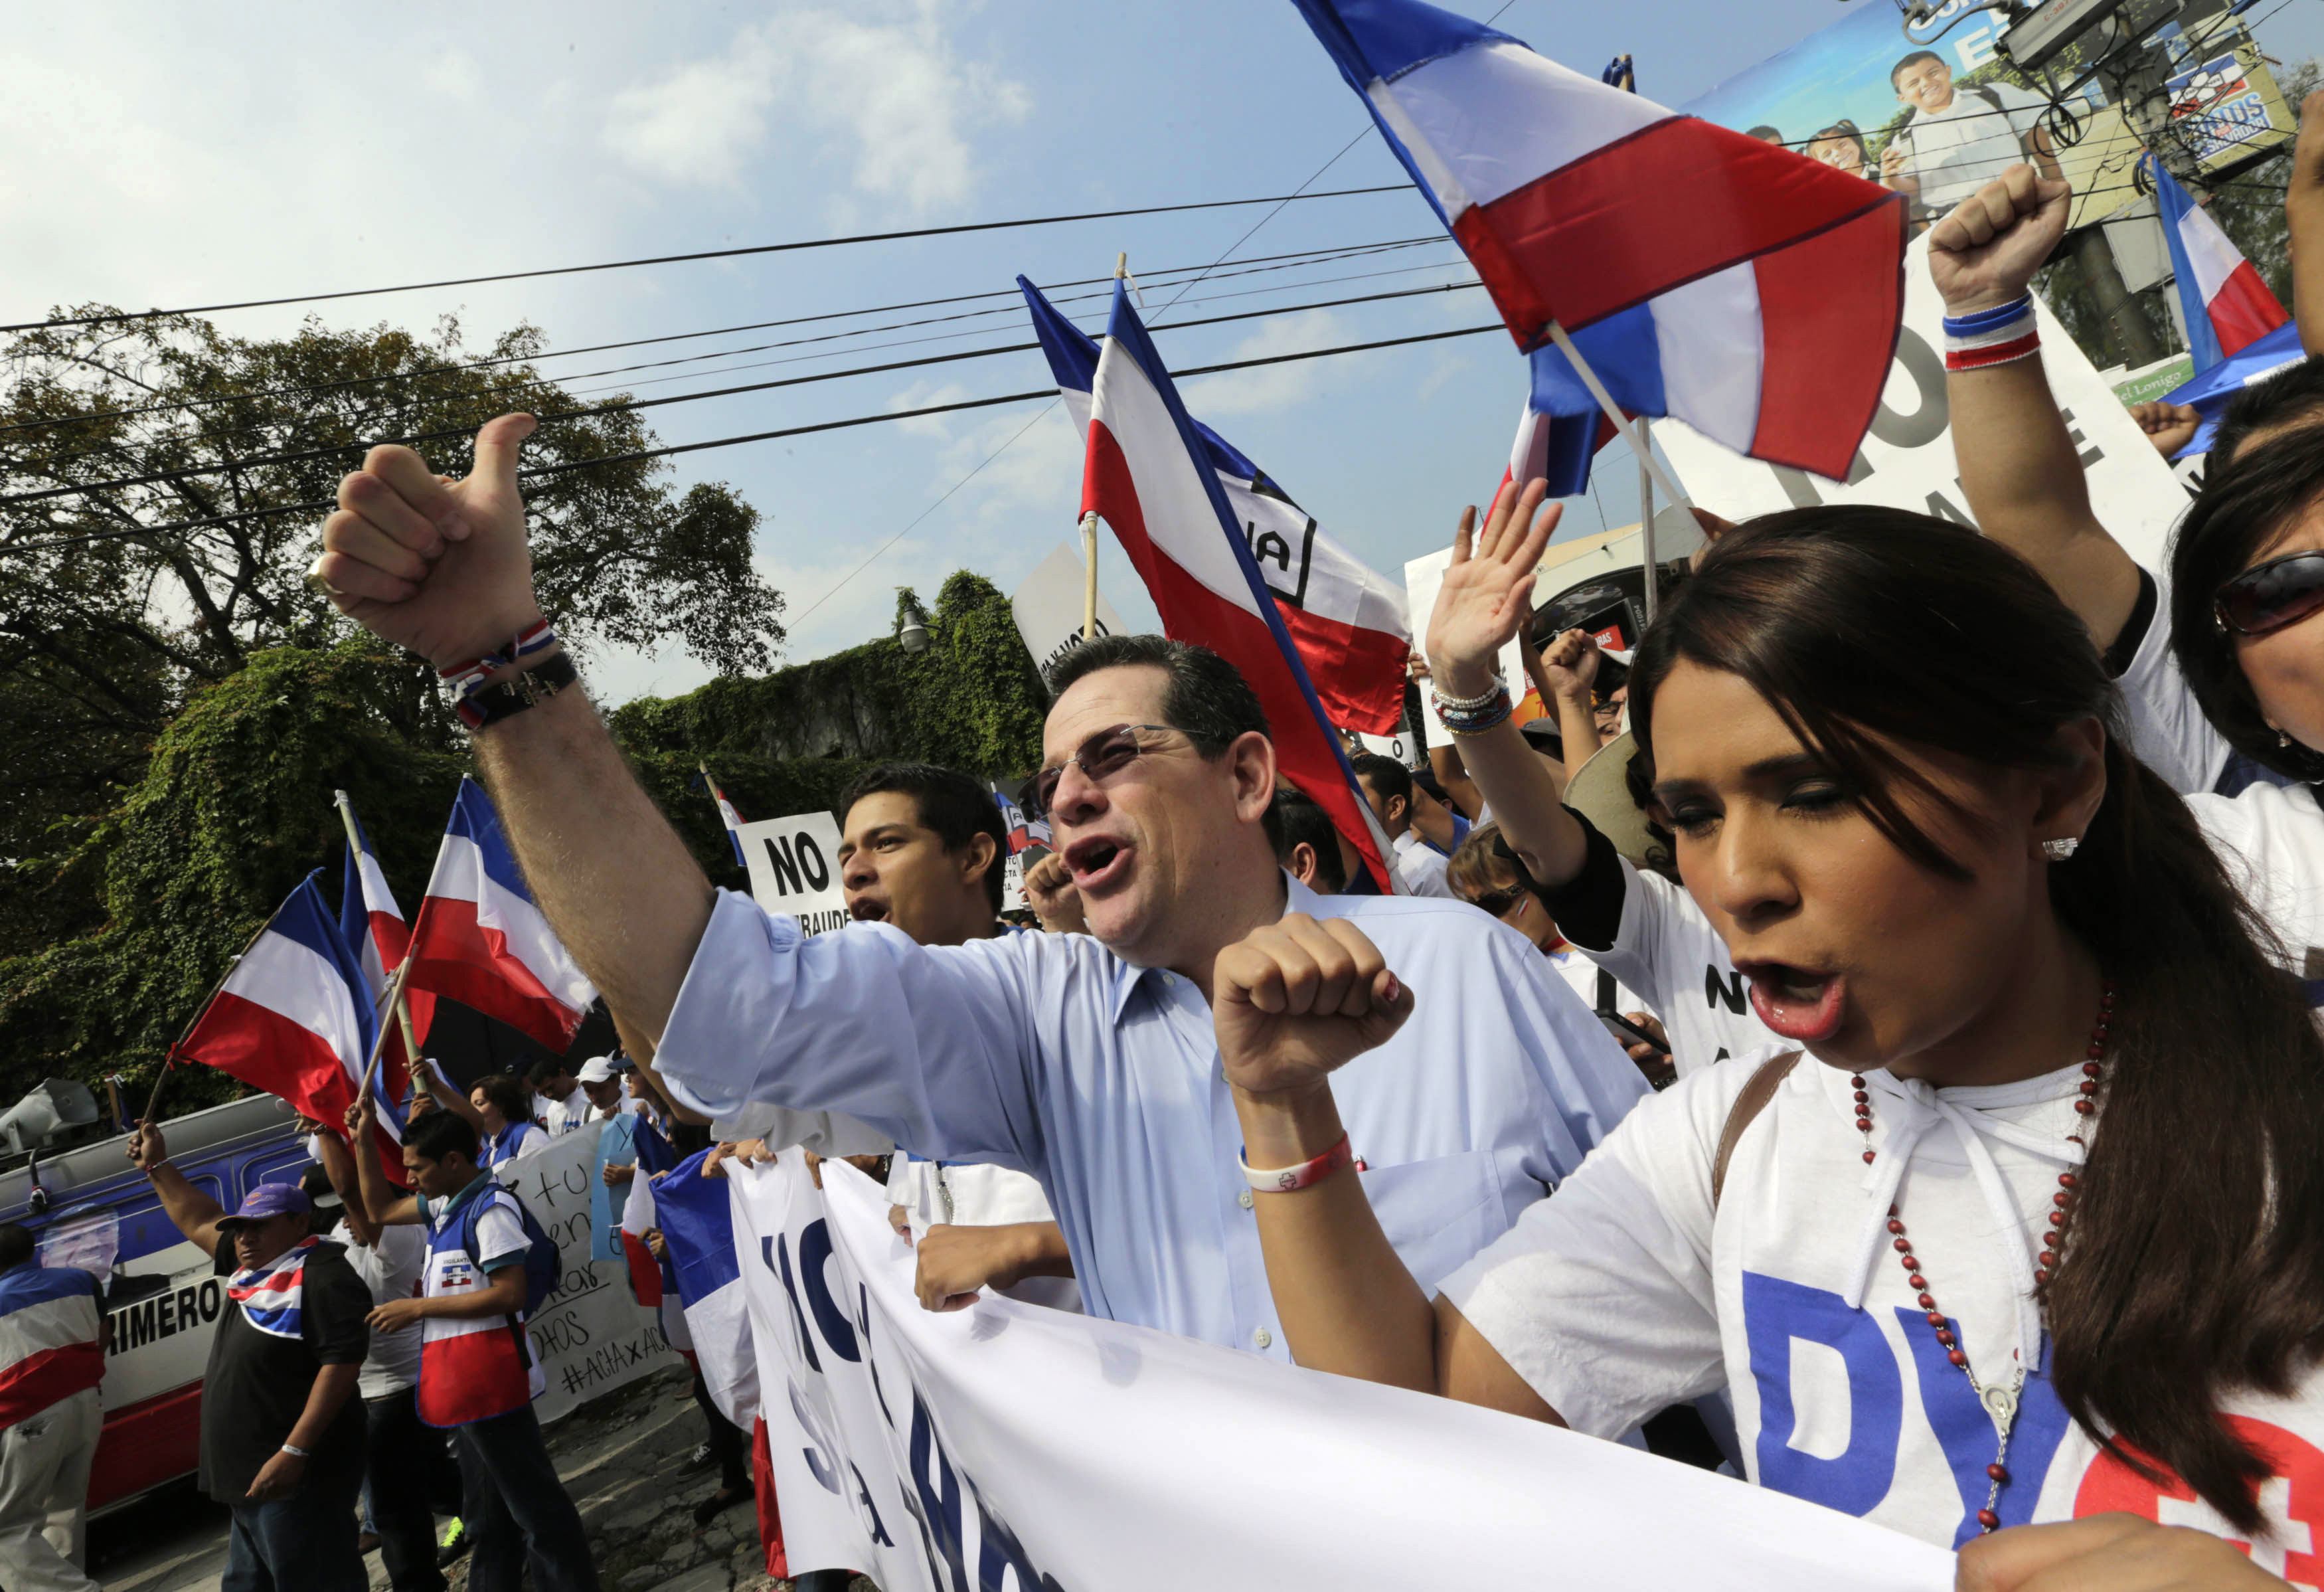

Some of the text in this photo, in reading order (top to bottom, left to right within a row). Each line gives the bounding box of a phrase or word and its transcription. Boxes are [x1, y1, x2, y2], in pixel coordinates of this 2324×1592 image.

[764, 831, 829, 897] NO
[794, 909, 851, 939] RAUDE
[1705, 964, 1753, 1016] N
[108, 1278, 221, 1357] RIMERO
